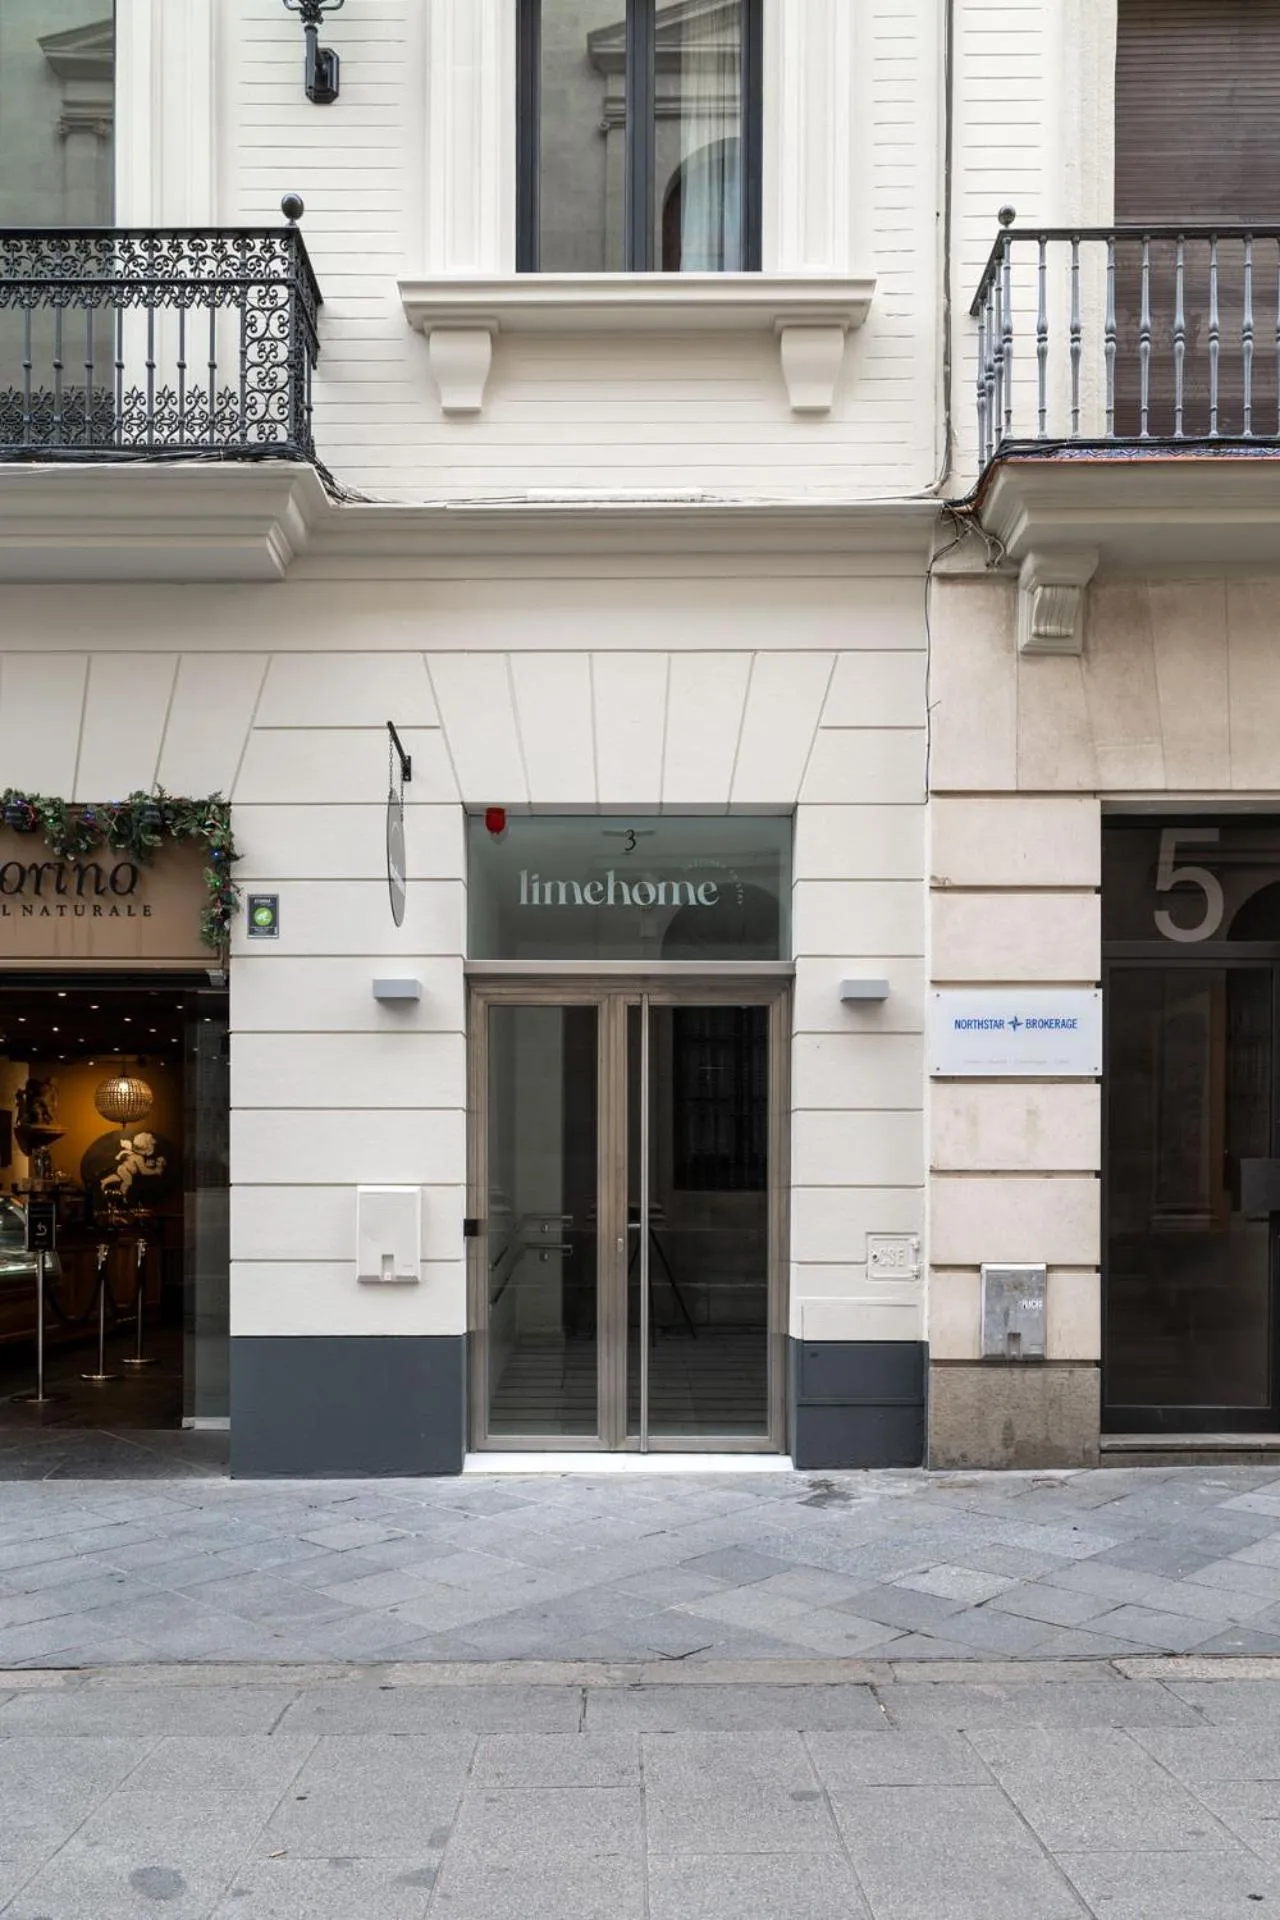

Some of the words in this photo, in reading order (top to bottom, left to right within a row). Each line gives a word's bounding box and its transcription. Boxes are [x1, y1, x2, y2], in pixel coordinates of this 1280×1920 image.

[623, 828, 637, 852] 3
[518, 869, 720, 906] limehome
[1153, 827, 1224, 943] 5
[22, 904, 153, 917] NATURALE
[954, 1018, 1005, 1030] NORTHSTAR
[1025, 1017, 1078, 1030] BROKERAGE
